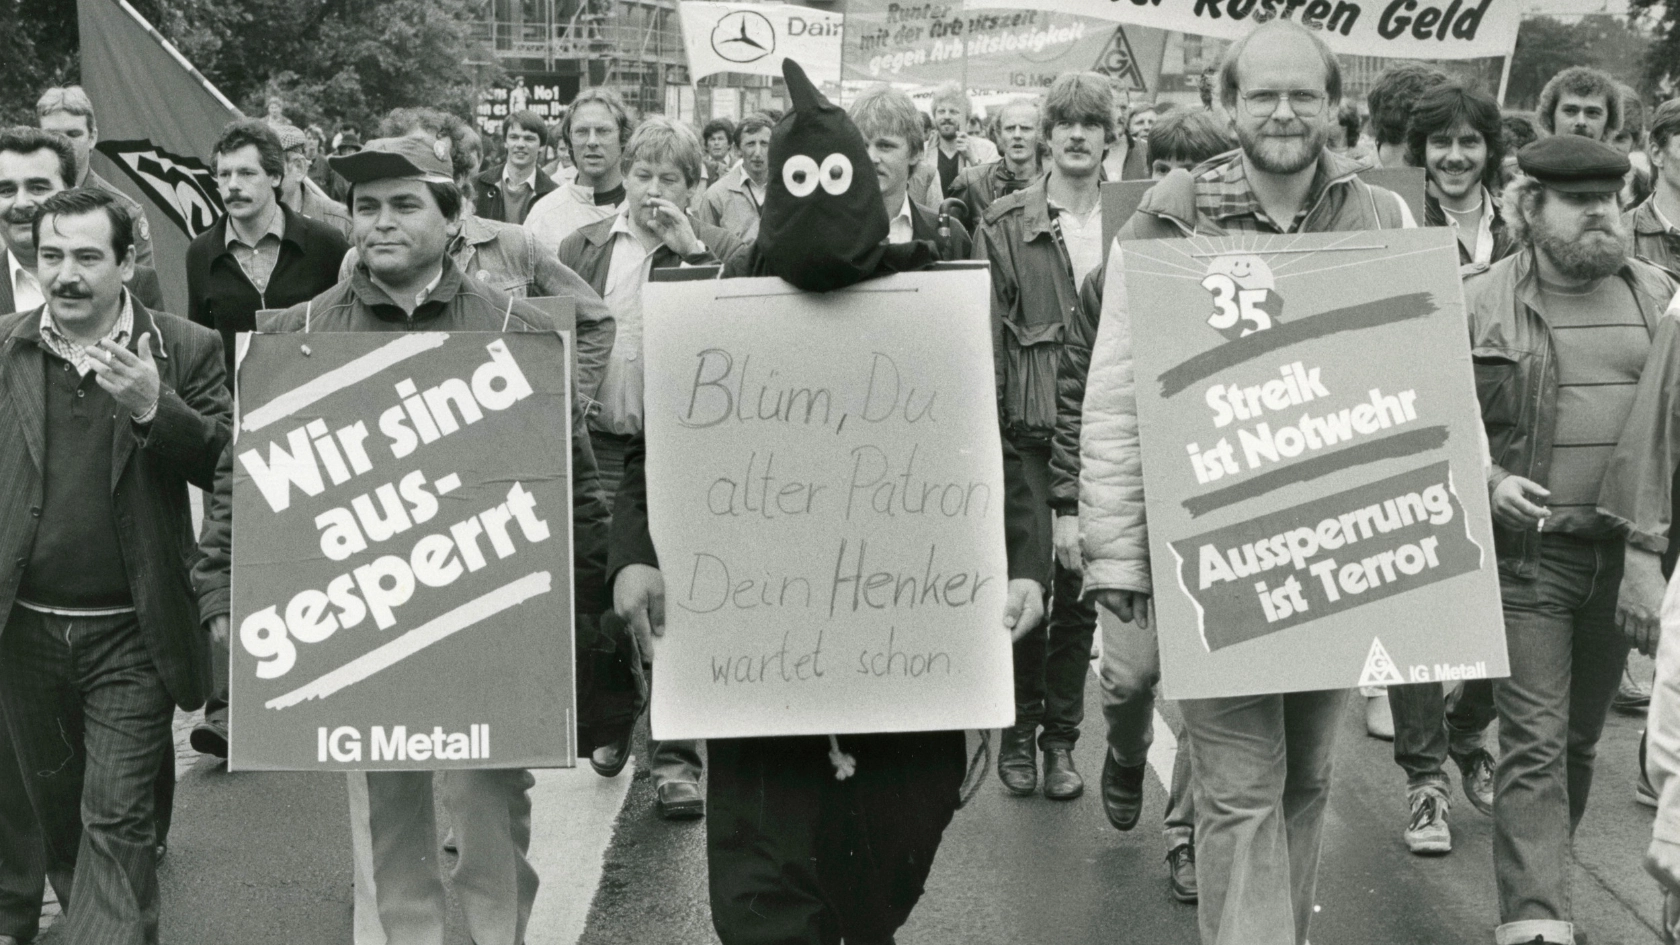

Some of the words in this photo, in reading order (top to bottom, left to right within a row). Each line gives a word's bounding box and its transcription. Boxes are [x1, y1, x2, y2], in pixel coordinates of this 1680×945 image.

[859, 28, 889, 50] mit
[892, 24, 924, 45] der
[886, 3, 951, 24] Runter
[1377, 0, 1493, 41] Geld
[869, 48, 926, 77] gegen
[1201, 273, 1273, 339] 35
[238, 417, 374, 514] Wir
[378, 337, 535, 460] sind
[677, 347, 849, 436] Blüm,
[859, 351, 938, 424] Du
[1204, 360, 1332, 429] Streik
[1185, 437, 1241, 485] ist
[1237, 387, 1418, 470] Notwehr
[313, 468, 463, 561] aus-
[706, 450, 828, 519] alter
[845, 442, 992, 521] Patron
[1198, 482, 1454, 591] Aussperrung
[239, 480, 551, 680] gesperrt
[676, 552, 811, 614] Dein
[829, 536, 995, 618] Henker
[1254, 574, 1309, 624] ist
[1309, 534, 1441, 603] Terror
[711, 629, 825, 686] wartet
[1409, 664, 1430, 683] IG
[1433, 660, 1487, 681] Metall
[317, 725, 362, 763] IG
[370, 723, 491, 762] Metall
